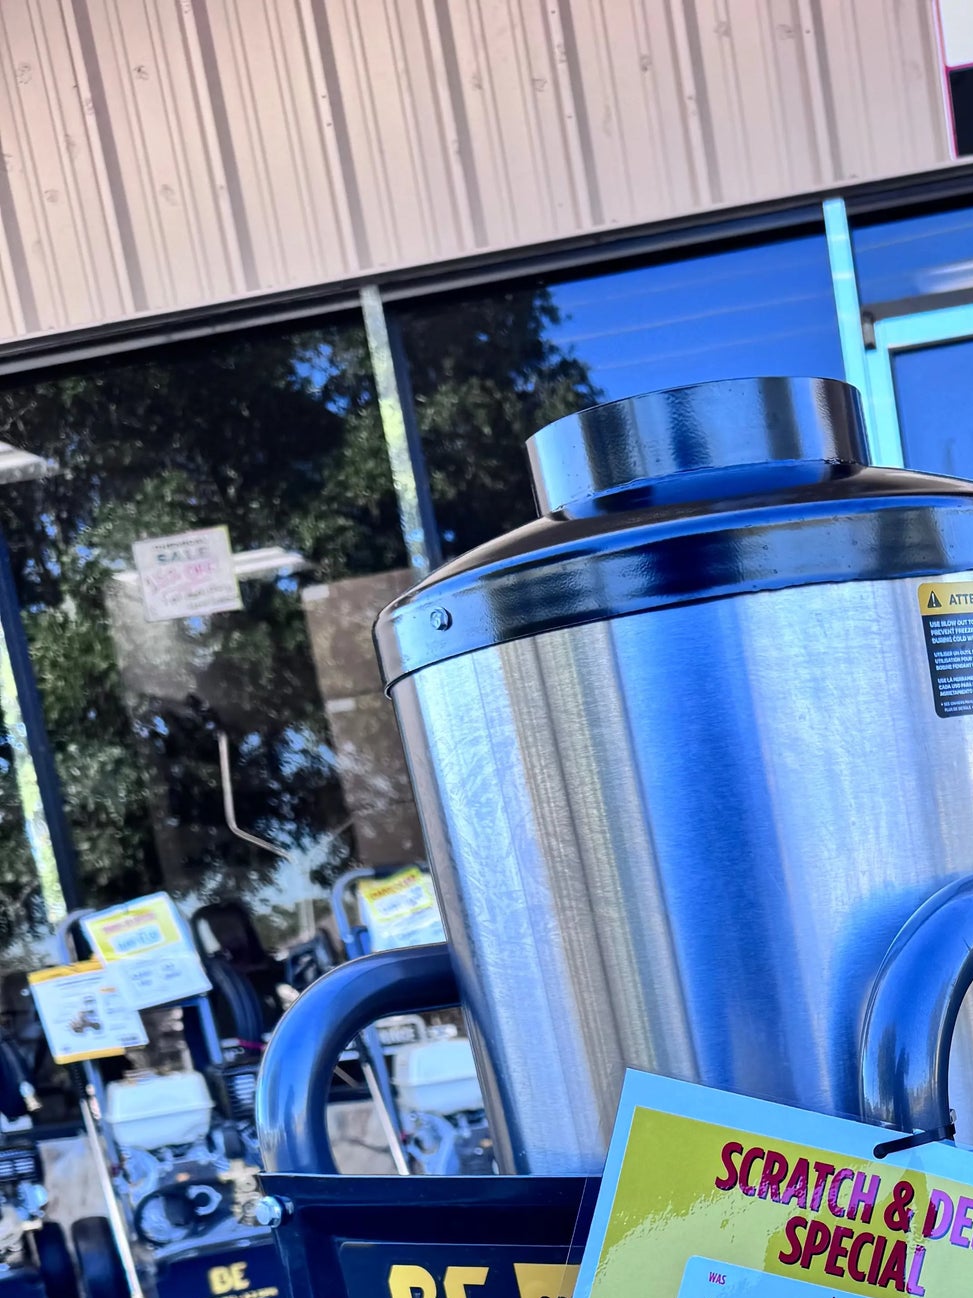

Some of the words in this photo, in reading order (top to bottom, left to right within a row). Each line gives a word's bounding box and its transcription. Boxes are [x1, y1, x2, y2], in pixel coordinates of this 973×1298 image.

[715, 1142, 881, 1223] SCRATCH
[883, 1182, 914, 1233] &
[208, 1261, 249, 1294] BE
[709, 1272, 726, 1285] WAS
[779, 1216, 926, 1297] SPECIAL
